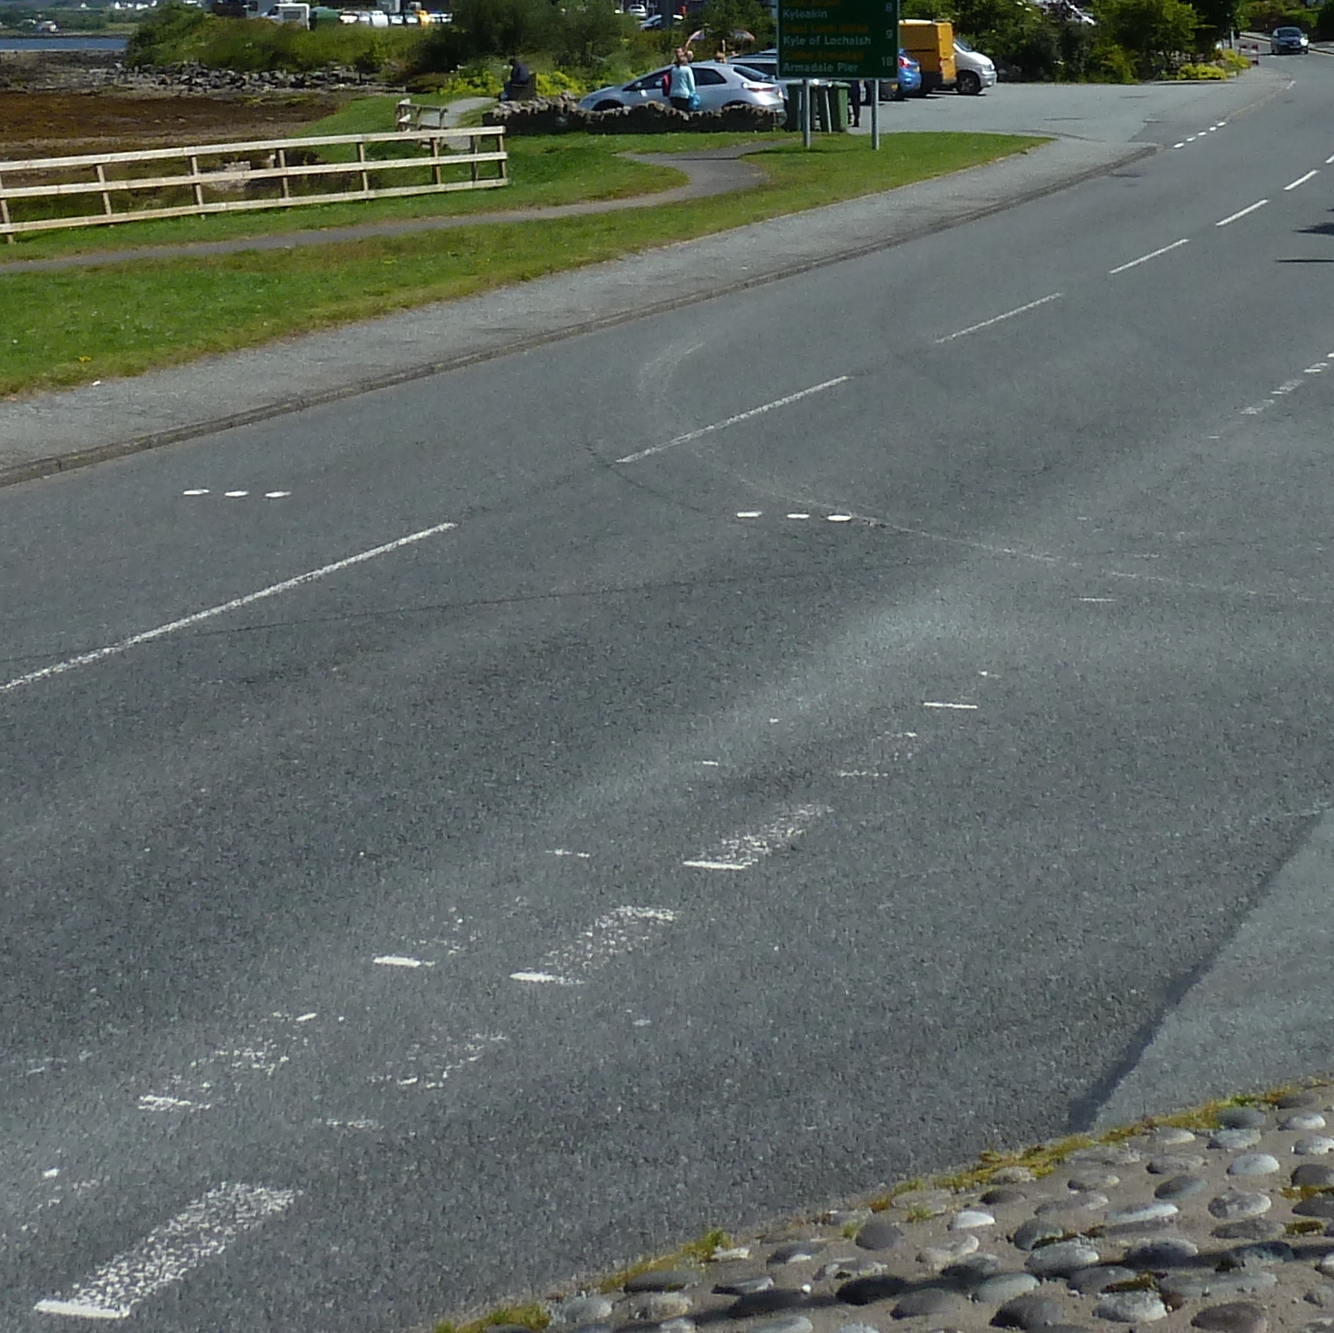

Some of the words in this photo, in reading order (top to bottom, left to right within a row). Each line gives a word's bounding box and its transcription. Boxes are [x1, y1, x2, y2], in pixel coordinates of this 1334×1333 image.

[782, 9, 828, 21] Kyleakin
[783, 36, 806, 47] Kyle
[809, 35, 821, 45] of
[824, 35, 872, 46] Lochalsh
[782, 62, 834, 72] Armadale
[837, 62, 859, 72] Pier
